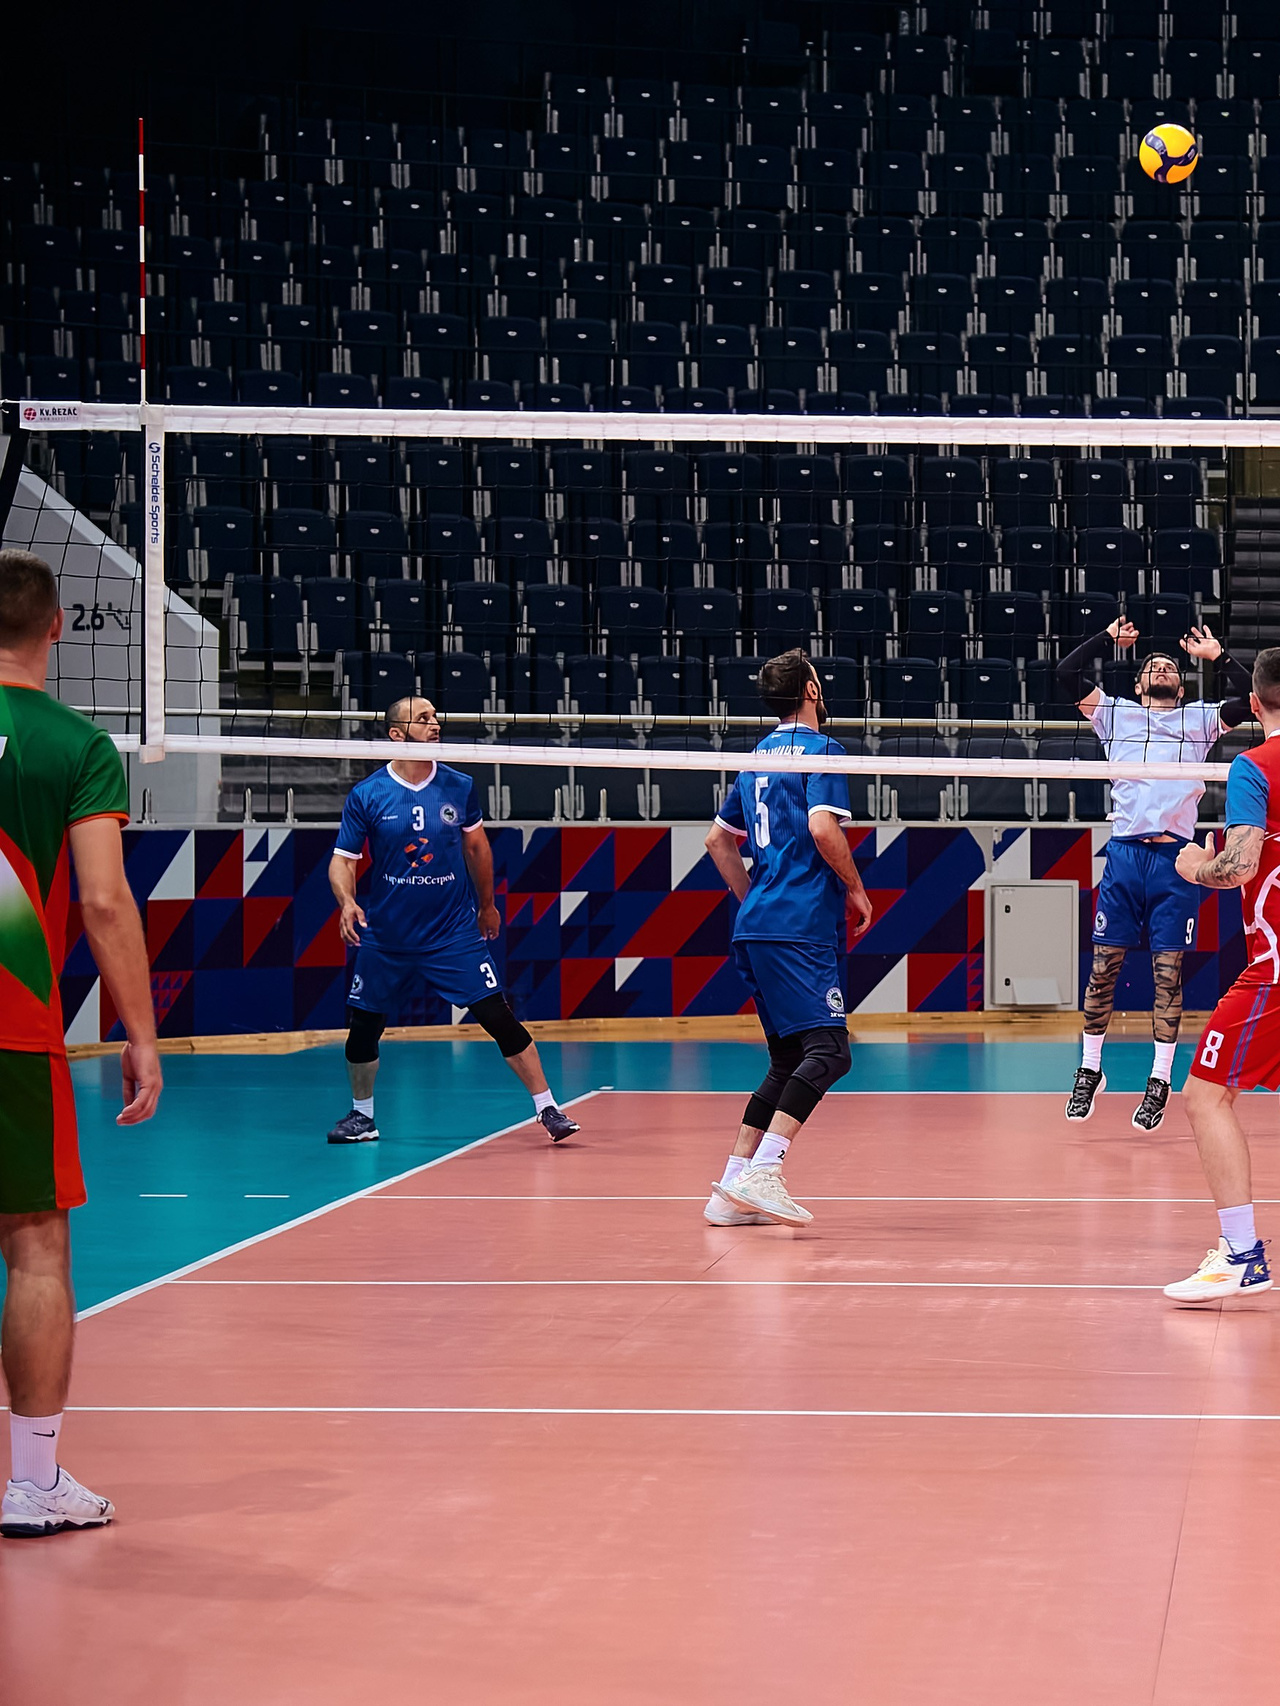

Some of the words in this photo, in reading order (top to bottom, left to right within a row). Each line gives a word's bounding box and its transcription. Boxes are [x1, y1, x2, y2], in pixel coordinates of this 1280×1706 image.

[151, 455, 161, 503] Schelde
[149, 505, 160, 544] Sports
[72, 603, 104, 631] 2.6
[412, 806, 425, 831] 3
[755, 776, 770, 849] 5
[1185, 918, 1195, 945] 9
[479, 962, 498, 989] 3
[1200, 1030, 1224, 1069] 8
